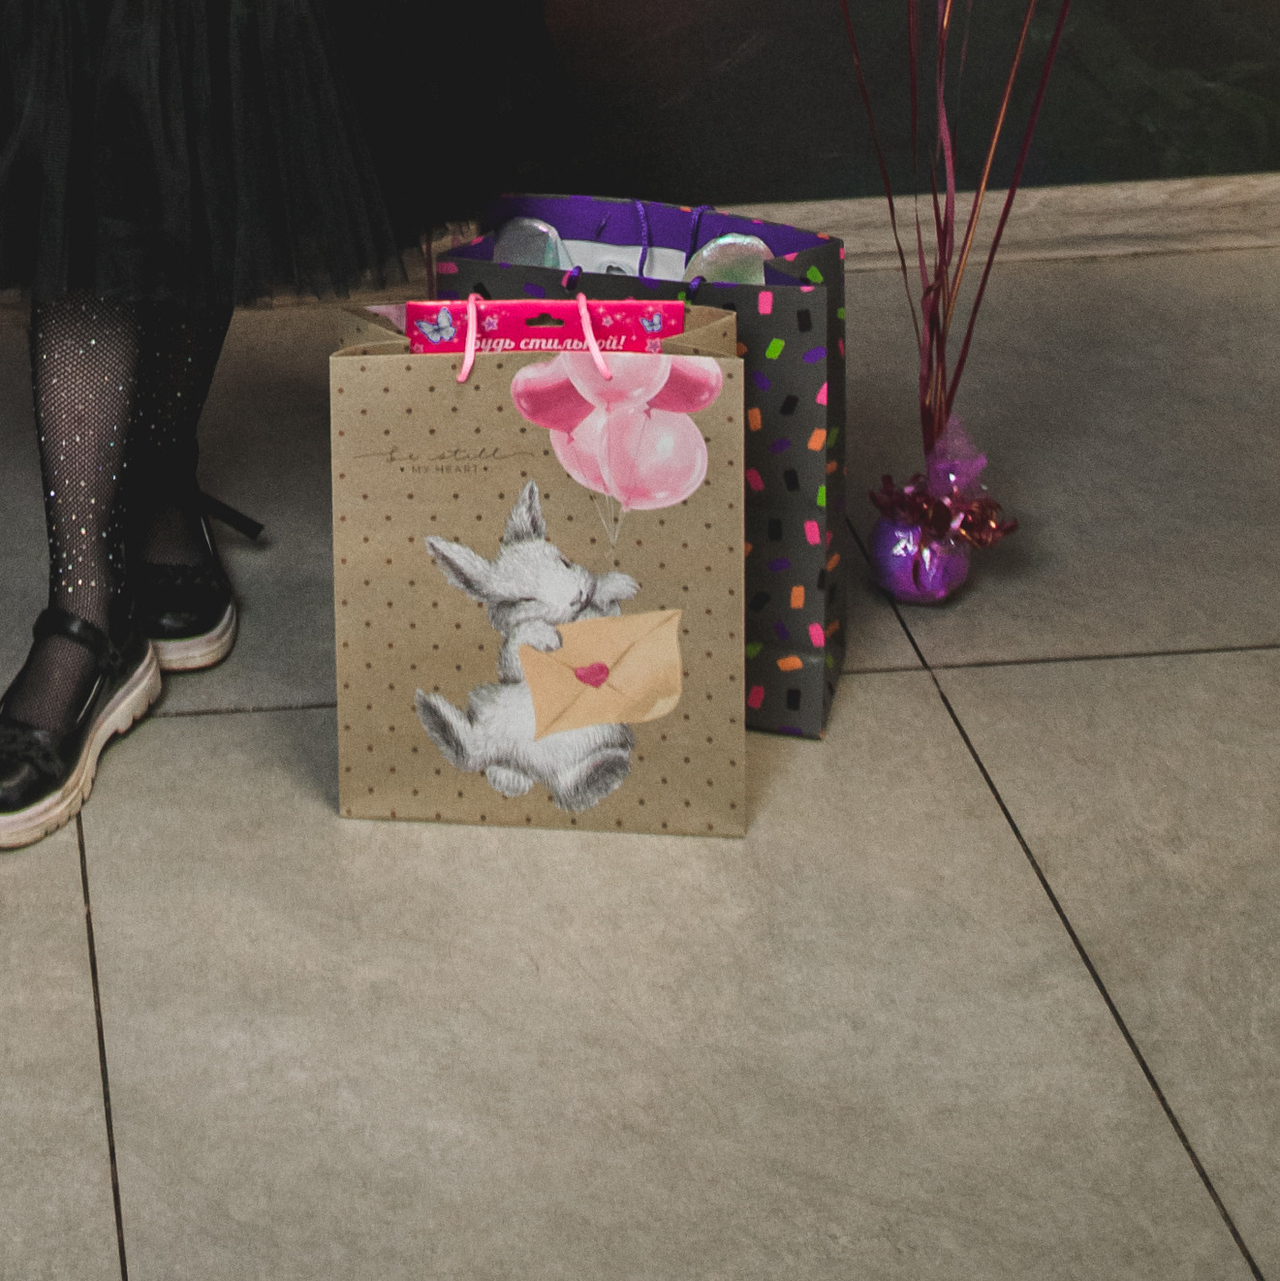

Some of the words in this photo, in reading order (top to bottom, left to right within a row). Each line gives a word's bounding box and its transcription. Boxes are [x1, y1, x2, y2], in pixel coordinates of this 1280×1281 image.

[519, 334, 627, 351] стильой!
[411, 464, 430, 474] MY
[434, 464, 479, 474] HEART
